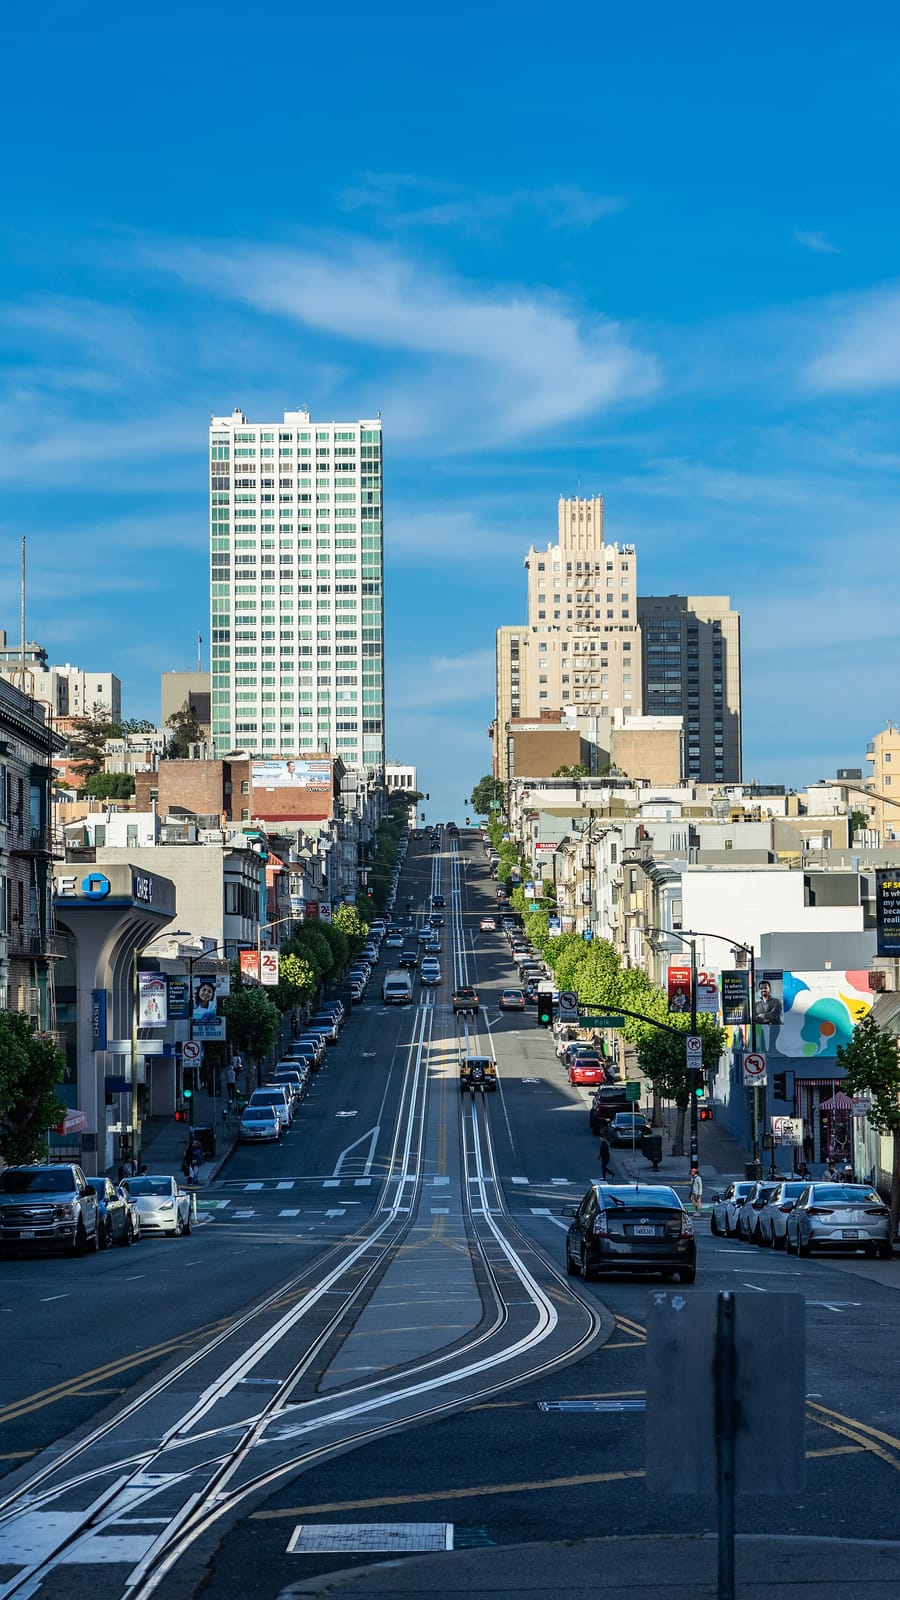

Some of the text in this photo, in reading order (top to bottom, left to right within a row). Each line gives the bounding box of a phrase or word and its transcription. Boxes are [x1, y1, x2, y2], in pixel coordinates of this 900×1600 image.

[882, 881, 892, 889] SF
[263, 955, 277, 971] 25
[697, 971, 716, 994] 25
[594, 1018, 610, 1026] Polk
